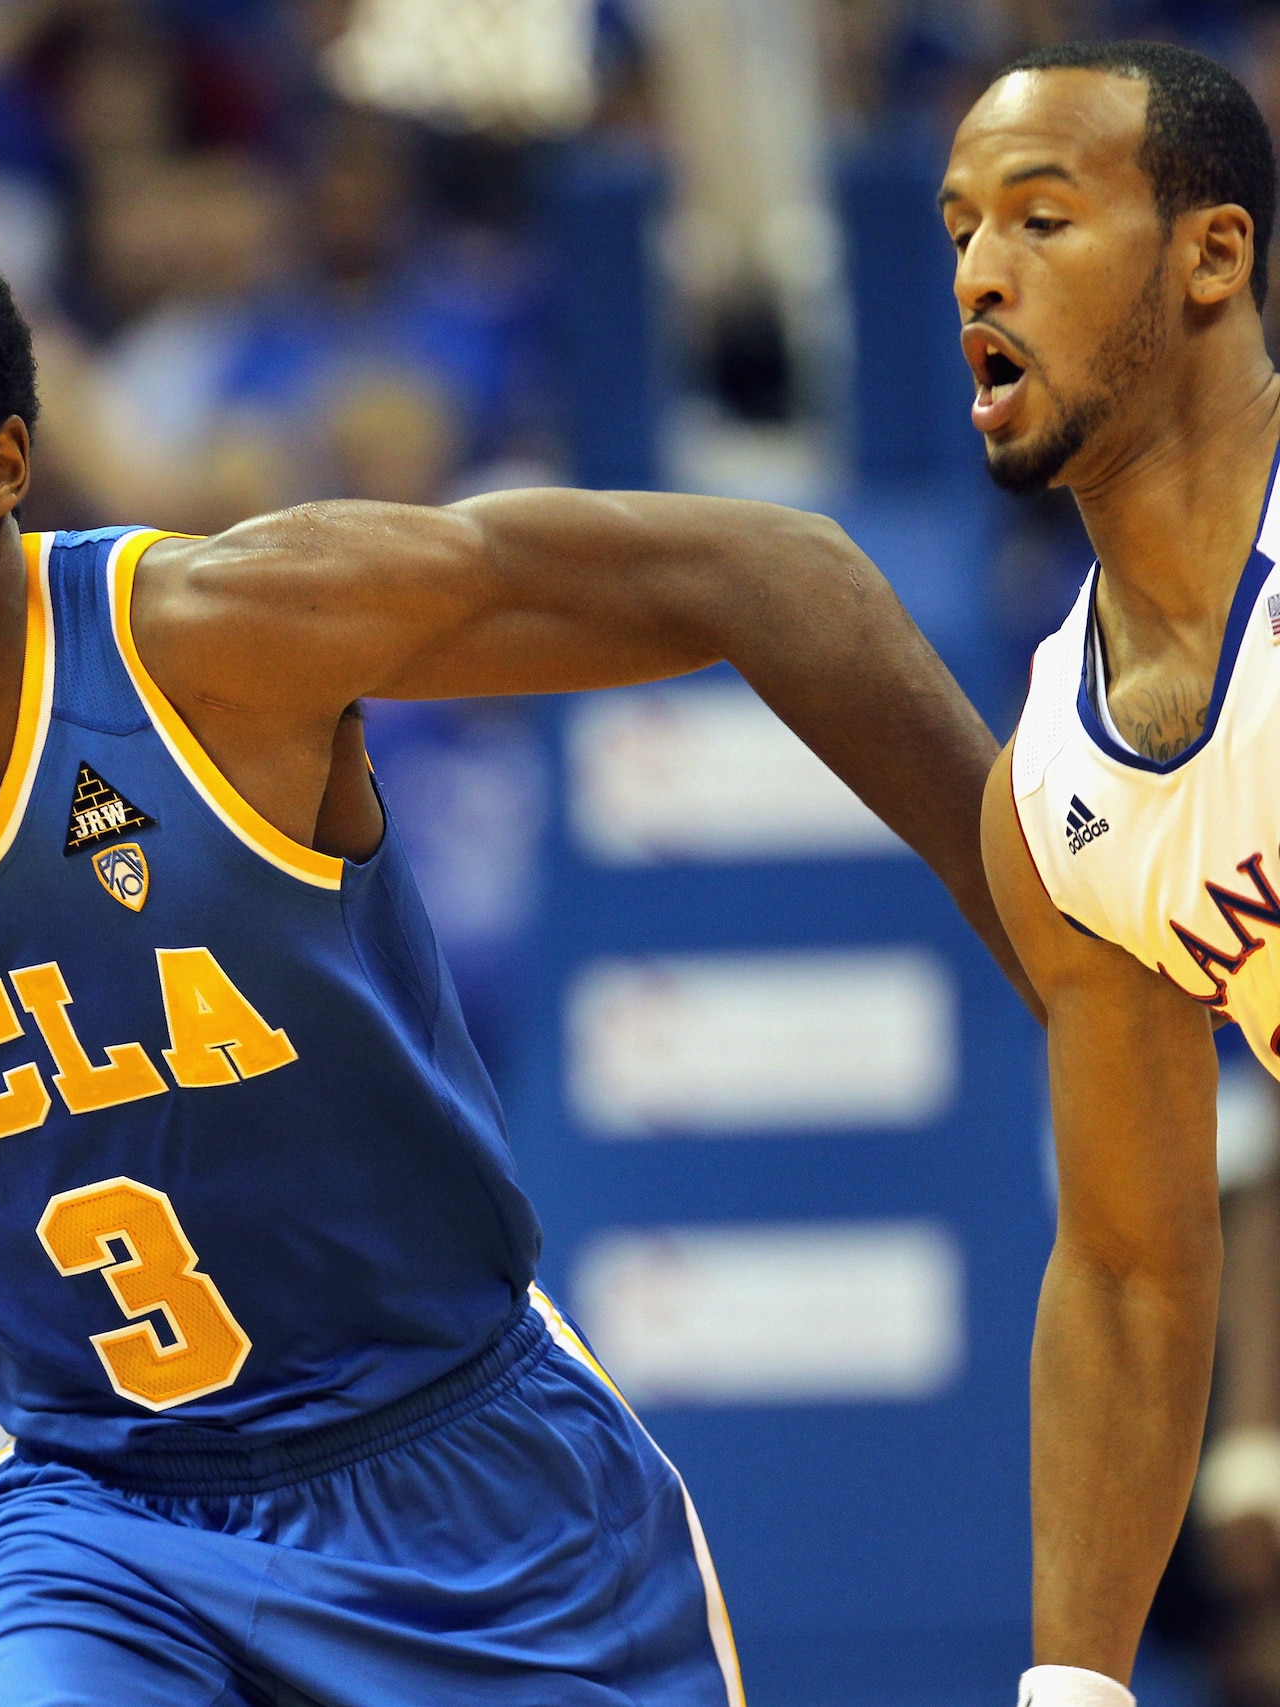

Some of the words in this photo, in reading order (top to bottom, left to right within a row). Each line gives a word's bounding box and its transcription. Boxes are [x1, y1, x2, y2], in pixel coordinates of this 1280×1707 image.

[75, 801, 127, 839] JRW
[1068, 818, 1109, 855] adidas
[115, 873, 143, 900] 10
[35, 1176, 253, 1412] 3
